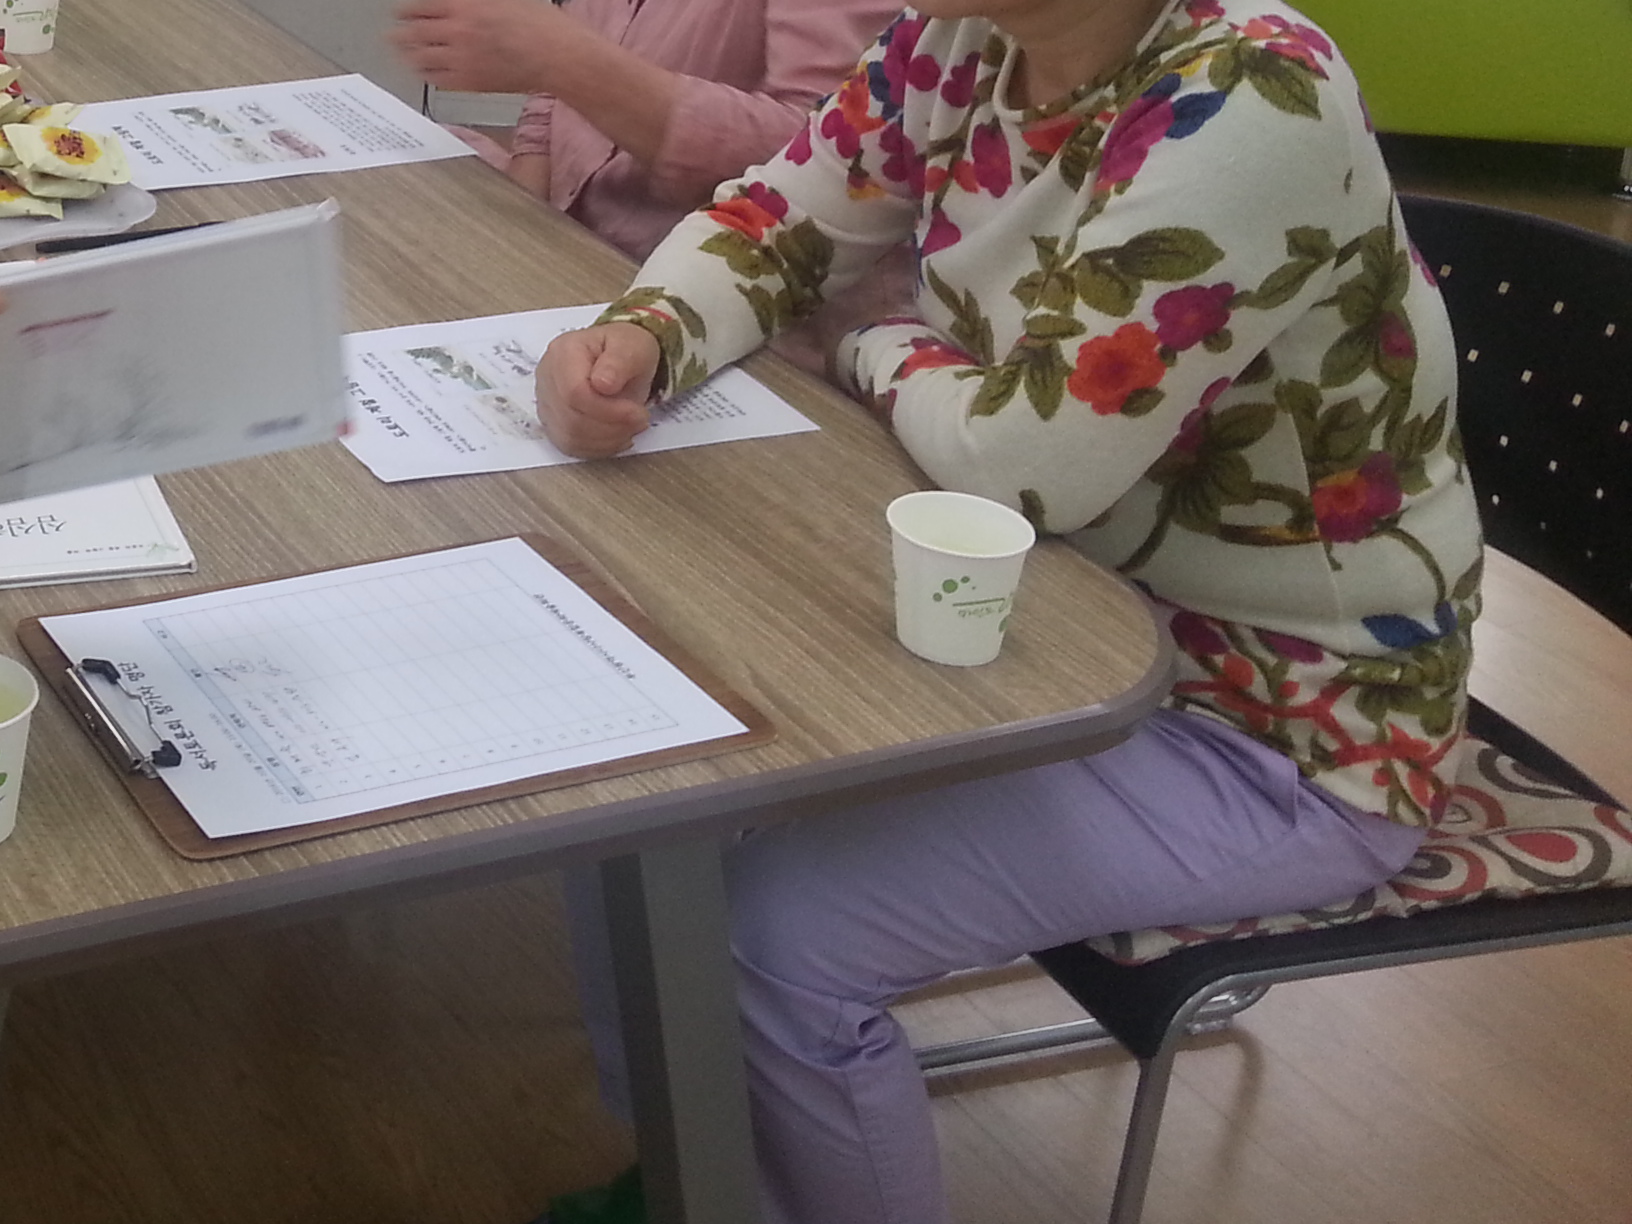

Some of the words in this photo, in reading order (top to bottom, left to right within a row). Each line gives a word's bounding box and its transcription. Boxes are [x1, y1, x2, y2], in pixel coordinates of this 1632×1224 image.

[114, 660, 148, 682] 명단
[134, 683, 175, 716] 참가자
[162, 718, 222, 772] 독서토론회
